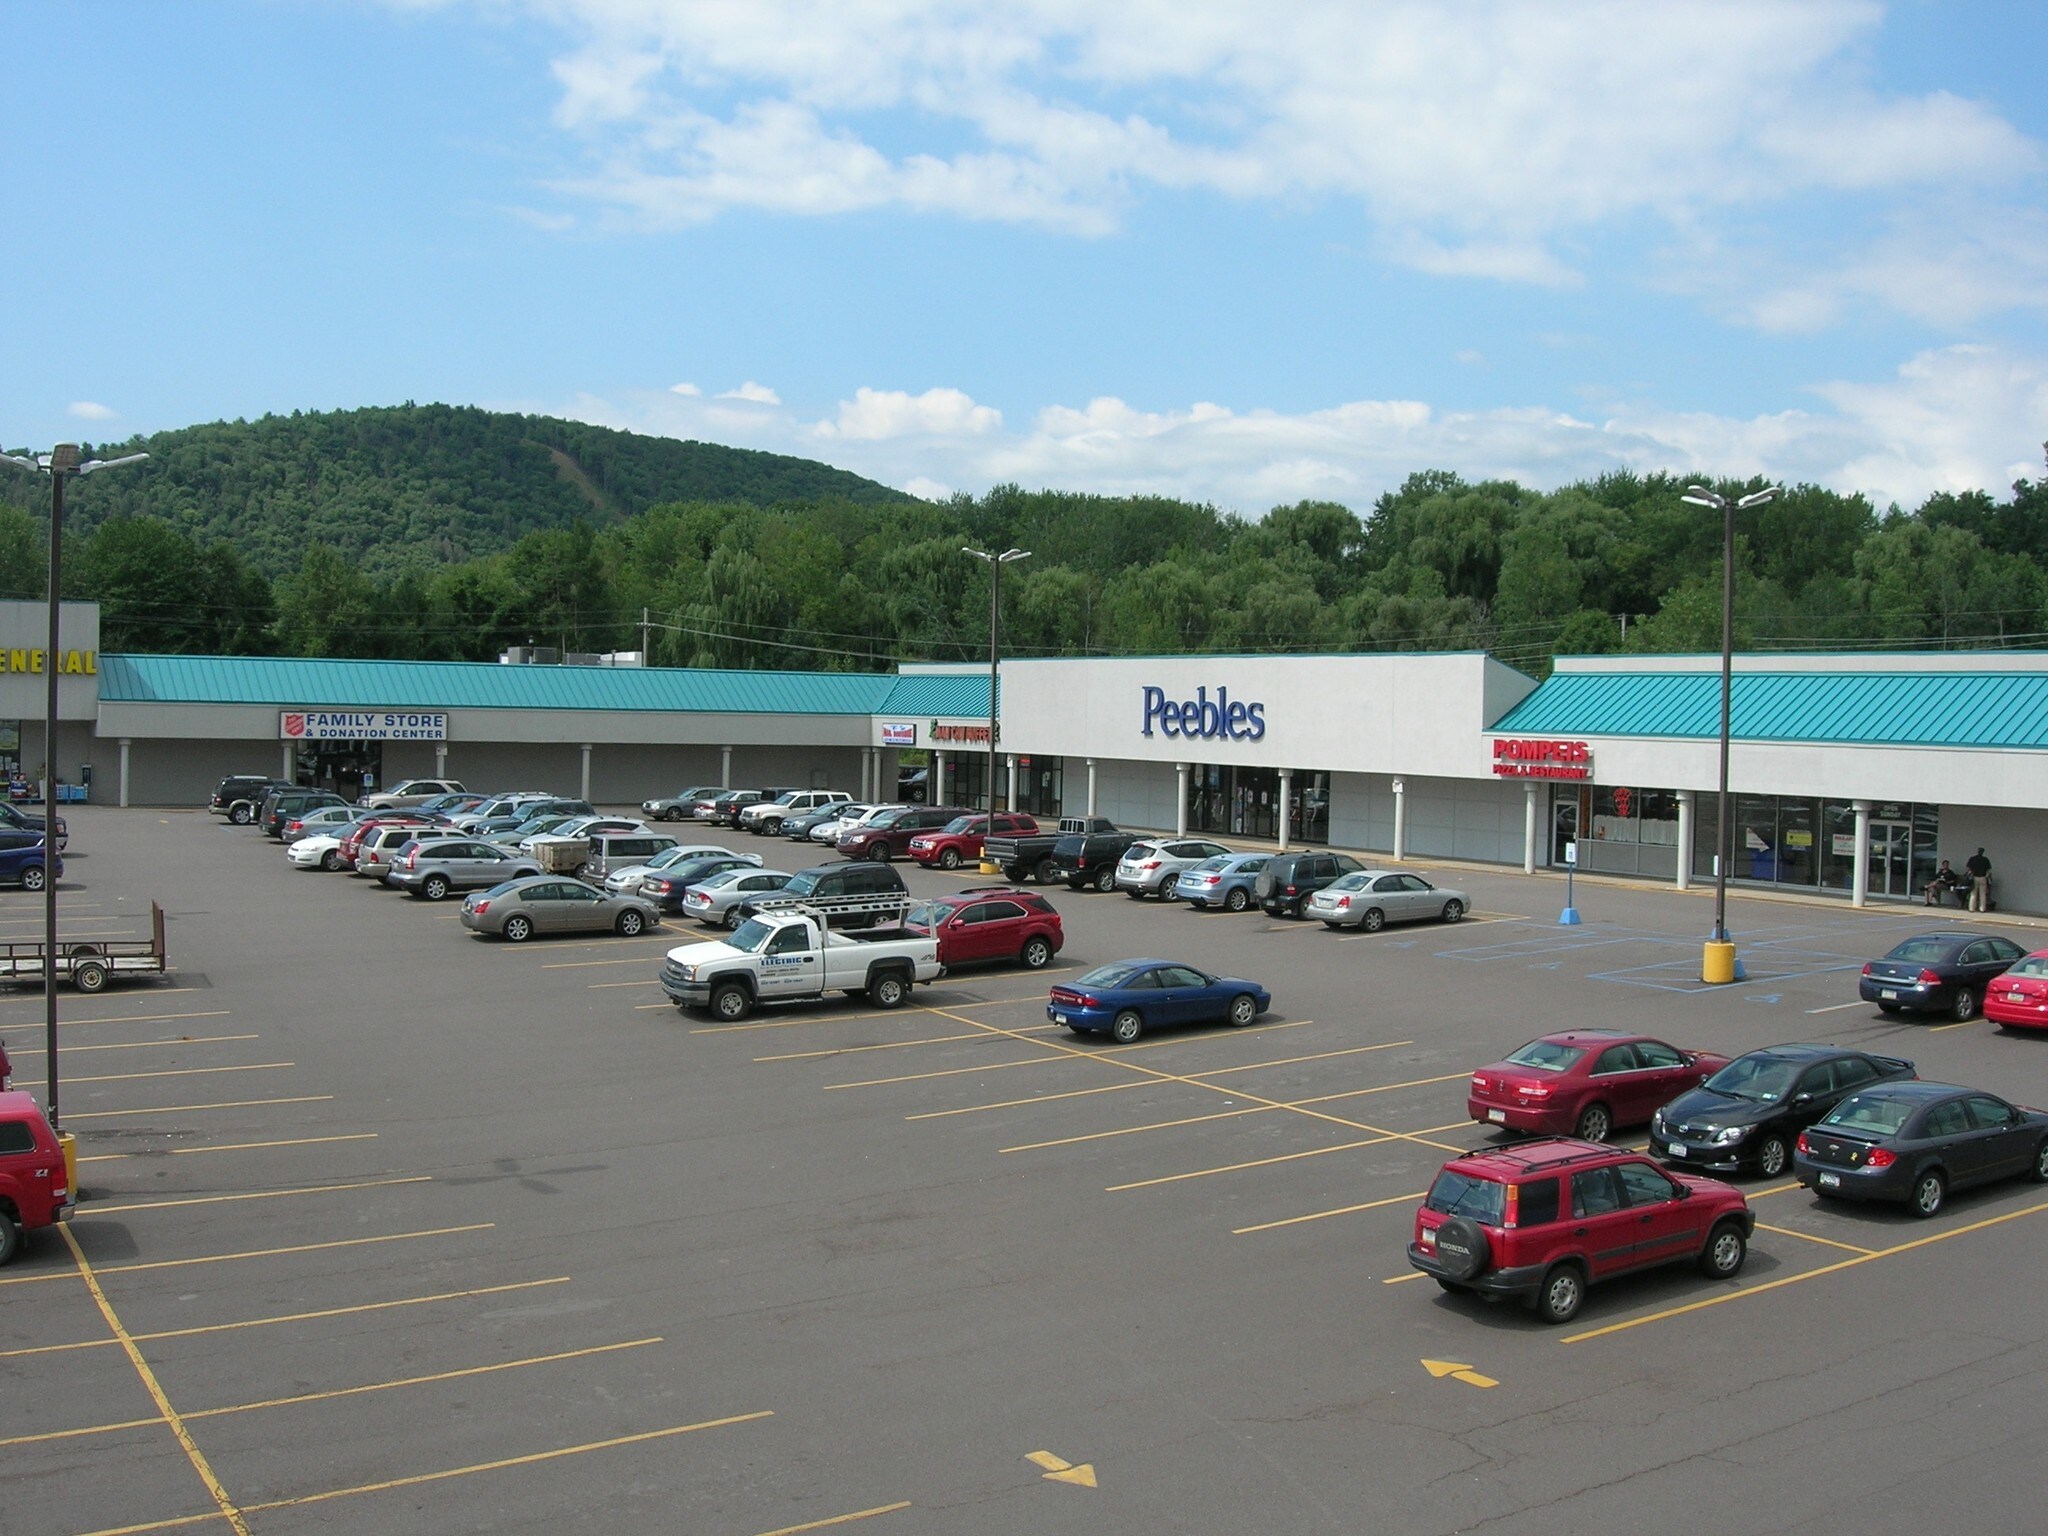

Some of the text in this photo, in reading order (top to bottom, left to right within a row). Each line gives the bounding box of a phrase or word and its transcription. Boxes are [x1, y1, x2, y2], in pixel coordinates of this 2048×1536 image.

[1141, 685, 1265, 739] Peebles
[306, 714, 375, 727] FAMILY
[384, 714, 443, 727] STORE
[305, 728, 443, 738] & DONATION CENTER
[1493, 739, 1588, 762] POMPEIS
[1529, 766, 1588, 779] RESTAURANT
[761, 957, 802, 966] ELECTRIC
[1439, 1241, 1471, 1255] HONDA
